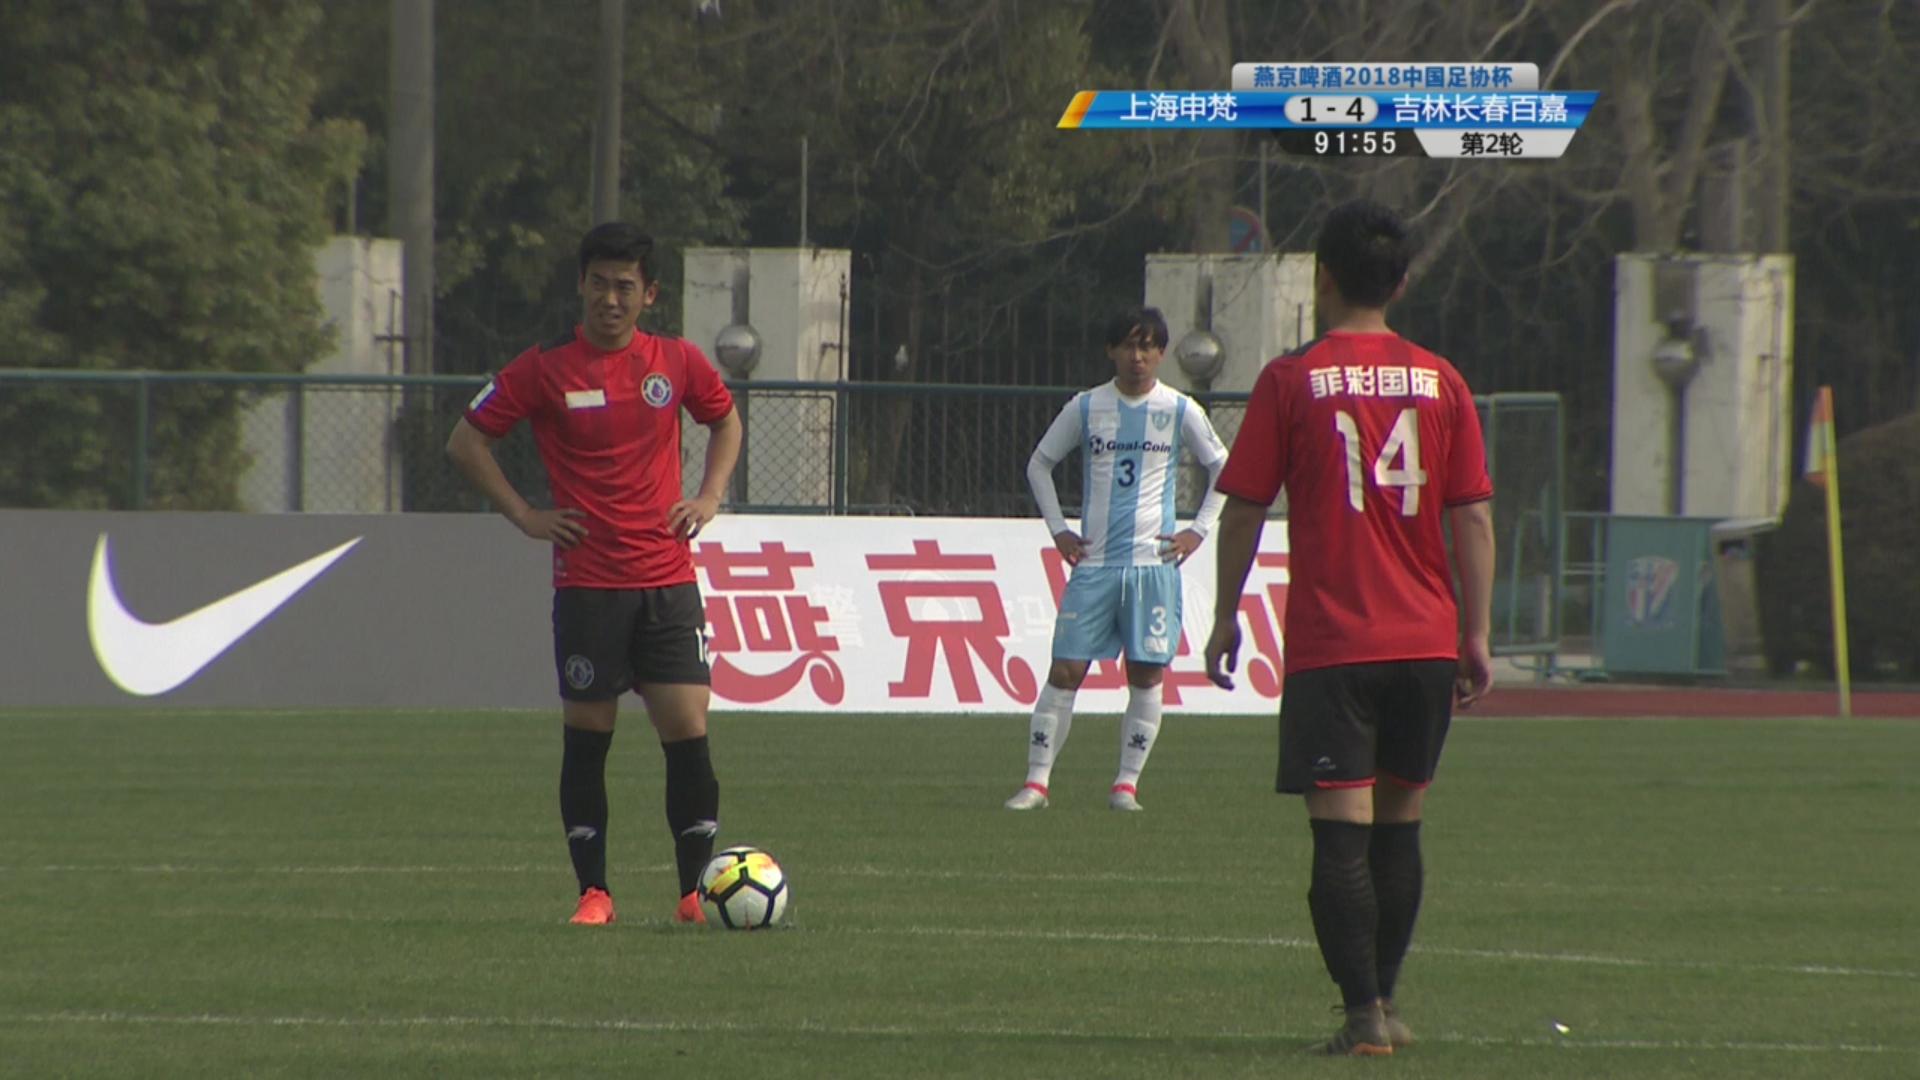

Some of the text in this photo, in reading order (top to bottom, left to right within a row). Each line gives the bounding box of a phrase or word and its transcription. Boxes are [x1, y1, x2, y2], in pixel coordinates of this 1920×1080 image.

[1309, 365, 1440, 399] 菲彩国际
[1106, 440, 1172, 453] Goal-Coin
[1335, 408, 1428, 516] 14
[1118, 458, 1136, 488] 3
[1150, 605, 1167, 636] 3
